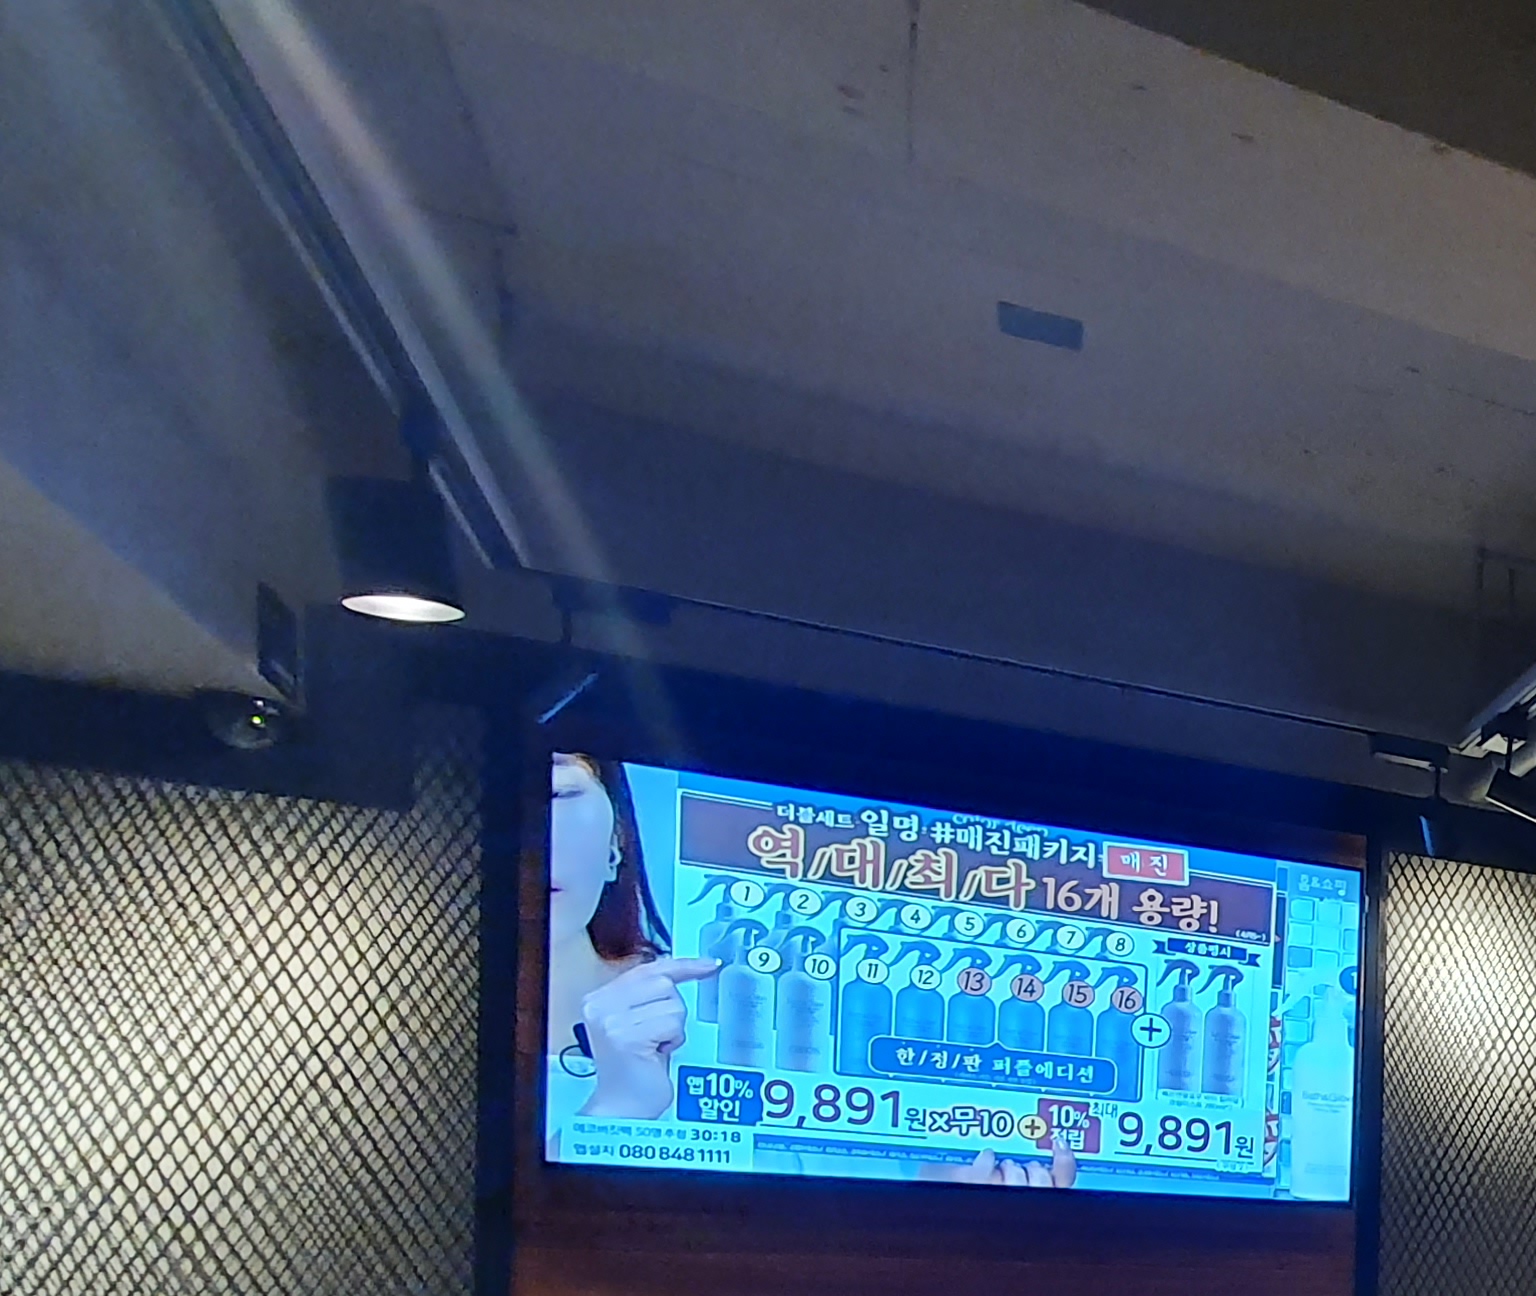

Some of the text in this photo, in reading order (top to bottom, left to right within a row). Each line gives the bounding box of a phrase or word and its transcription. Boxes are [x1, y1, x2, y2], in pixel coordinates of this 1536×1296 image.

[860, 808, 920, 841] 일명
[930, 821, 1096, 869] #매진패키지
[743, 886, 751, 902] 1
[797, 893, 810, 910] 2
[854, 901, 867, 917] 3
[1043, 876, 1120, 921] 16개
[1133, 888, 1219, 934] 용량!
[910, 909, 921, 923] 4
[964, 916, 976, 932] 5
[1016, 924, 1027, 938] 6
[1066, 931, 1076, 944] 7
[1114, 937, 1126, 951] 8
[758, 952, 770, 968] 9
[811, 958, 829, 975] 10
[867, 963, 879, 979] 11
[917, 969, 933, 985] 12
[963, 970, 984, 991] 13
[1015, 976, 1036, 997] 14
[1066, 983, 1088, 1003] 15
[1116, 989, 1137, 1009] 16
[992, 1055, 1095, 1083] 퍼플에디션
[698, 1096, 741, 1123] 할인
[1048, 1104, 1090, 1128] 10%
[690, 1128, 741, 1143] 30:18
[1092, 1102, 1254, 1159] 최대 9,891원
[619, 1144, 656, 1159] 080
[658, 1146, 695, 1162] 848
[697, 1148, 730, 1164] 1111
